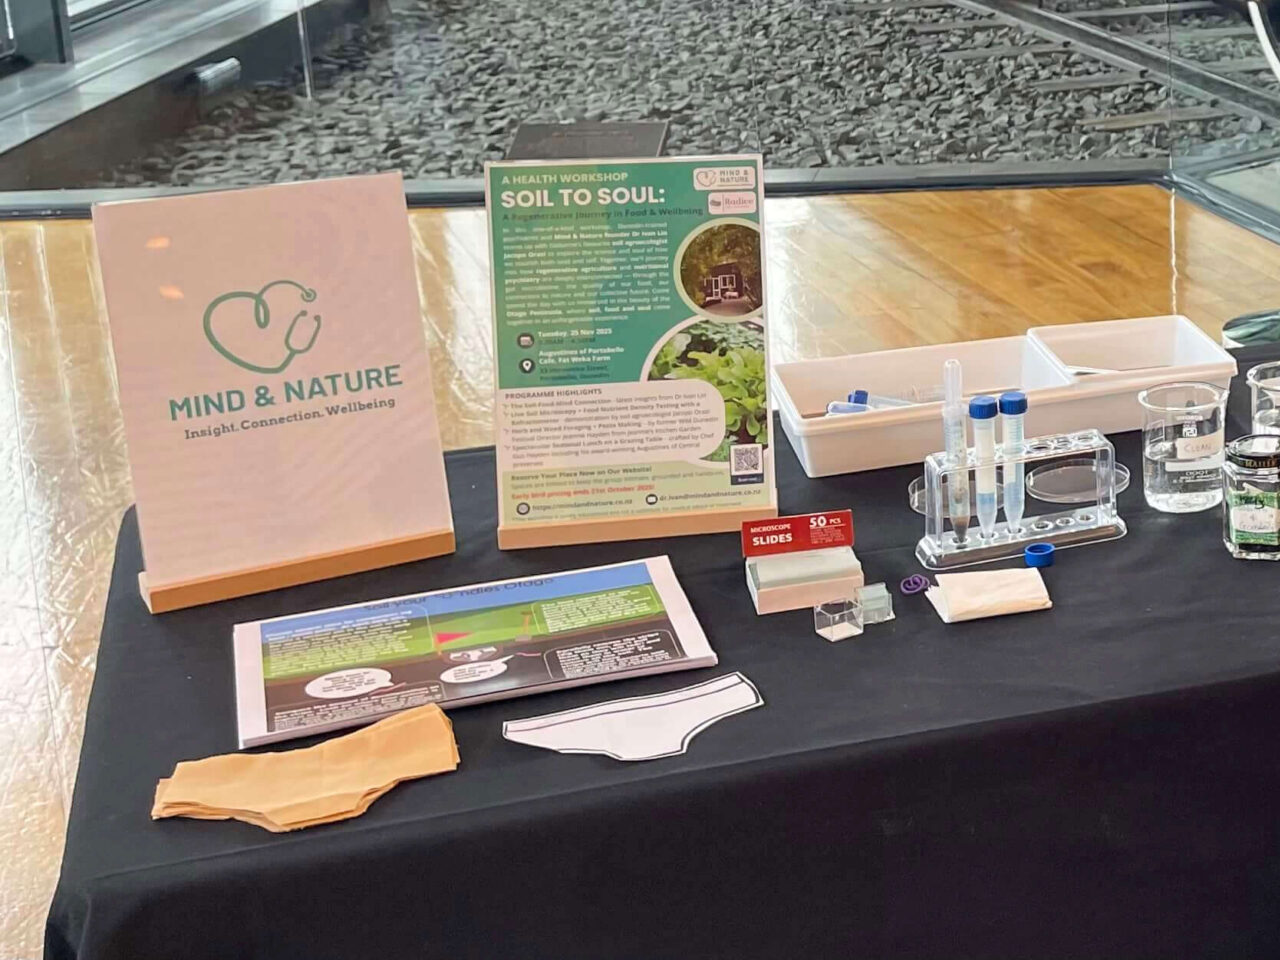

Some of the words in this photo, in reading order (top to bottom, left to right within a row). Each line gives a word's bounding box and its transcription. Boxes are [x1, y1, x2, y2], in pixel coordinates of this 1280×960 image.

[502, 176, 509, 184] A
[513, 174, 557, 184] HEALTH
[560, 172, 628, 183] WORKSHOP
[501, 190, 554, 208] SOIL
[559, 188, 592, 207] TO
[598, 186, 666, 206] SOUL:
[576, 211, 610, 219] Journey
[614, 209, 623, 217] in
[625, 208, 647, 216] Food
[650, 208, 657, 216] &
[659, 206, 703, 216] Wellbeing
[168, 389, 246, 421] MIND
[254, 385, 276, 408] &
[283, 364, 404, 402] NATURE
[505, 391, 555, 399] PROGRAMME
[557, 388, 602, 397] HIGHLIGHTS
[184, 422, 240, 440] Insight.
[240, 410, 325, 431] Connection.
[325, 398, 396, 417] Wellbeing
[1184, 443, 1212, 453] CLEAN
[809, 516, 827, 527] 50
[750, 524, 791, 533] MICROSCOPE
[752, 533, 793, 546] SLIDES
[394, 596, 426, 608] your
[504, 579, 553, 590] Otago
